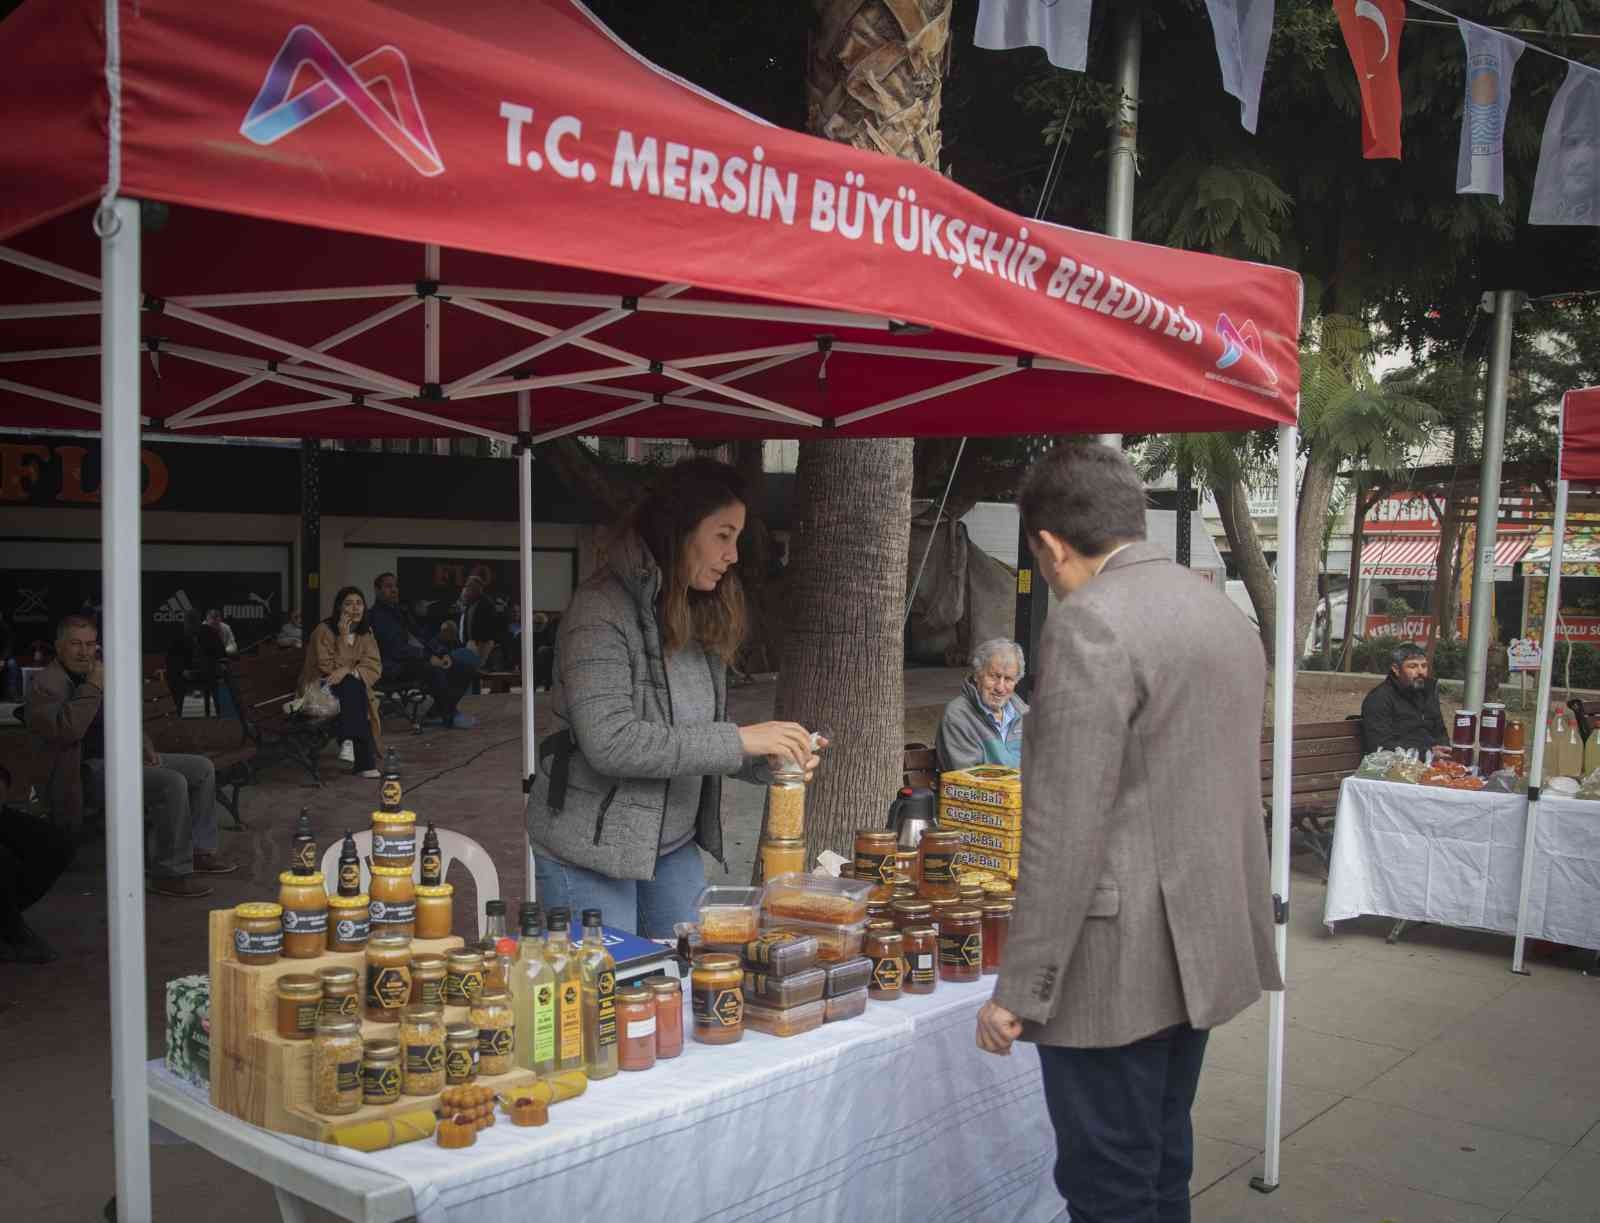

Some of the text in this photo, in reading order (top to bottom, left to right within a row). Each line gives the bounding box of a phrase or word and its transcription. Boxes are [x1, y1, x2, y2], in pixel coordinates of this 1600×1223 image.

[499, 101, 597, 183] T.C.
[610, 130, 799, 225] MERSİN
[810, 170, 1048, 291] BÜYÜKŞEHİR
